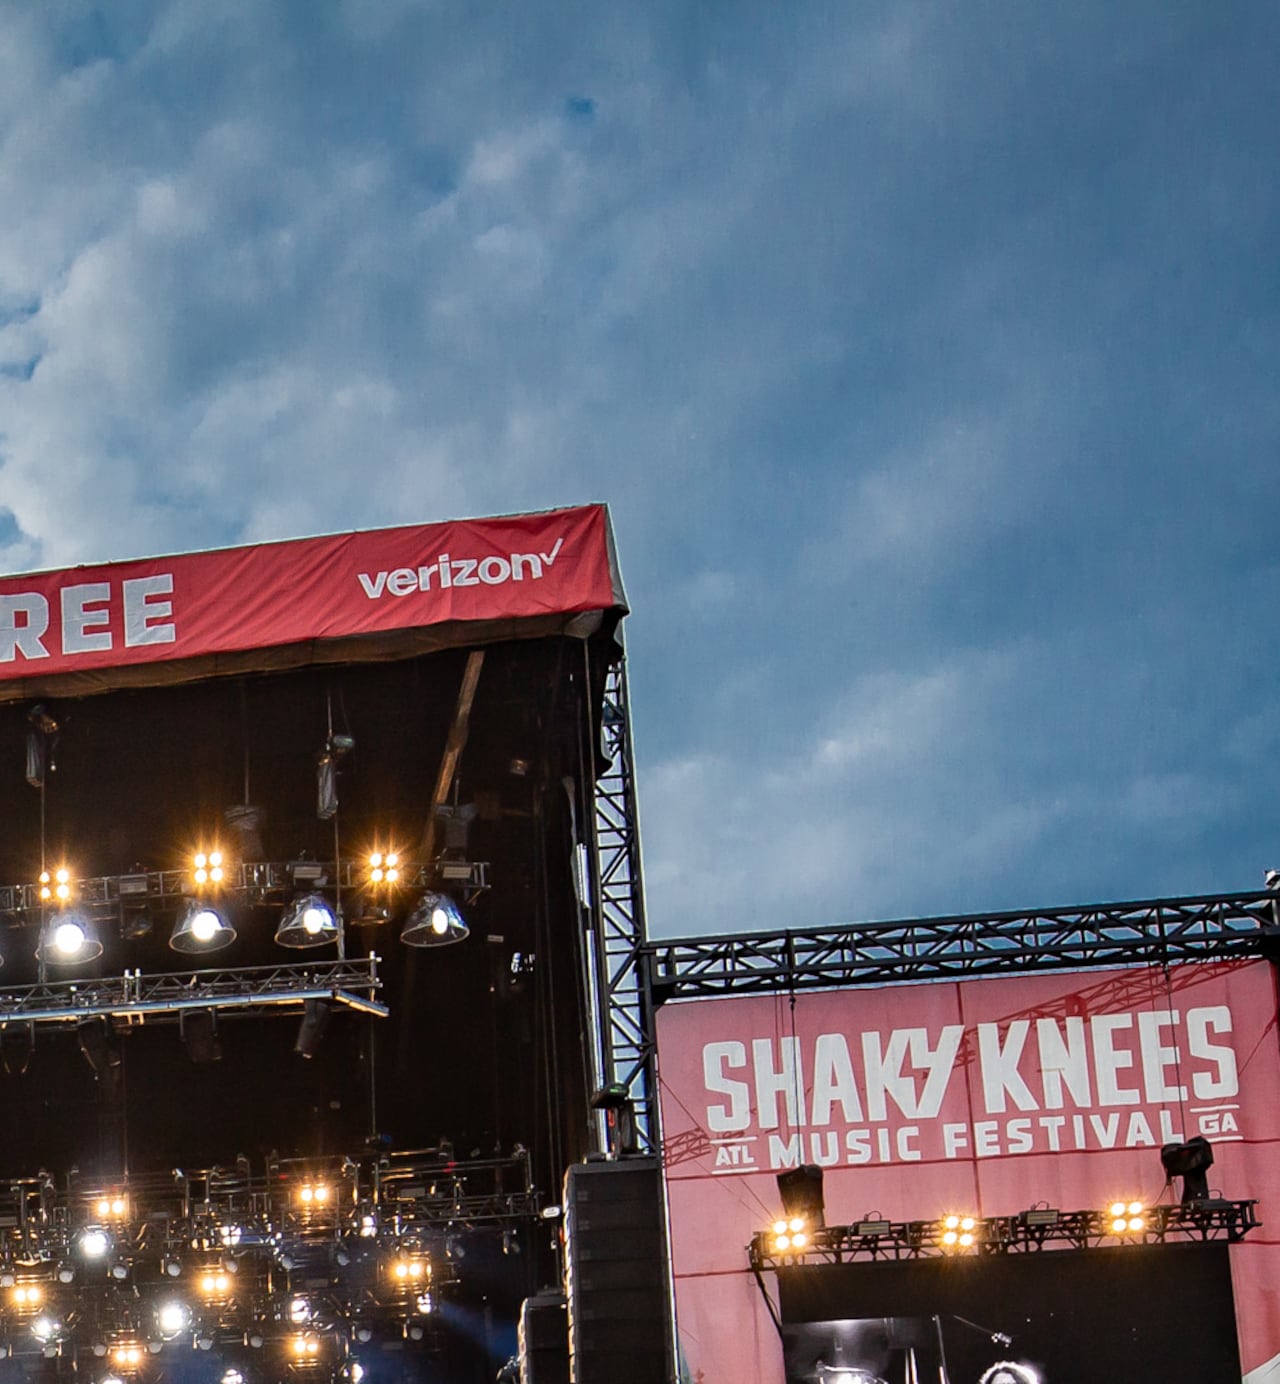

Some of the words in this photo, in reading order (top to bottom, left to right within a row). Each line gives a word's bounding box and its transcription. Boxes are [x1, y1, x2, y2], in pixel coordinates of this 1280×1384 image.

[358, 553, 543, 600] verizon
[703, 1024, 965, 1133] SHAKY
[978, 1005, 1240, 1114] KNEES
[715, 1144, 756, 1166] ATL
[768, 1125, 923, 1170] MUSIC
[944, 1110, 1185, 1159] FESTIVAL
[1198, 1112, 1239, 1135] GA
